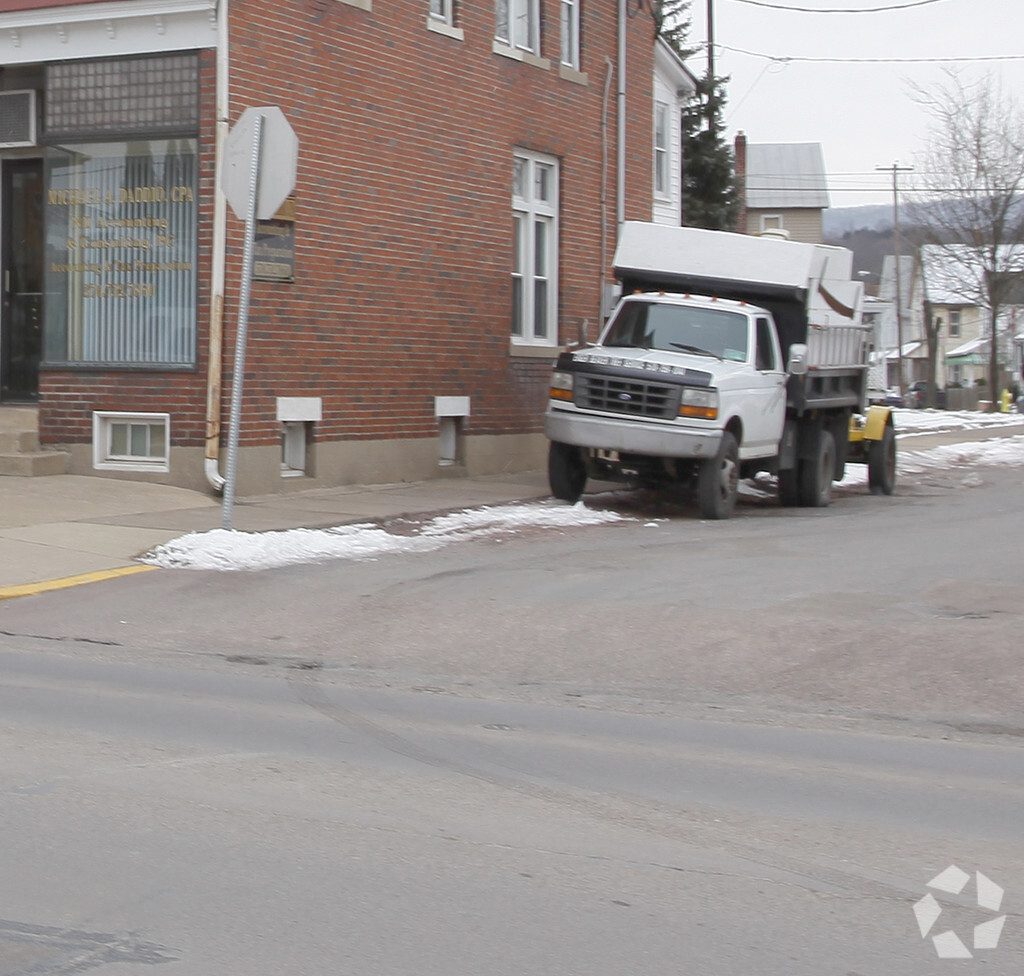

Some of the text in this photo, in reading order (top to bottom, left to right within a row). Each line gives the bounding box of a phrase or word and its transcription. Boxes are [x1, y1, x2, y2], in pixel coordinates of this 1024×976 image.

[47, 187, 101, 205] MICHAEL
[171, 185, 194, 203] CPA
[96, 213, 168, 231] Accounting
